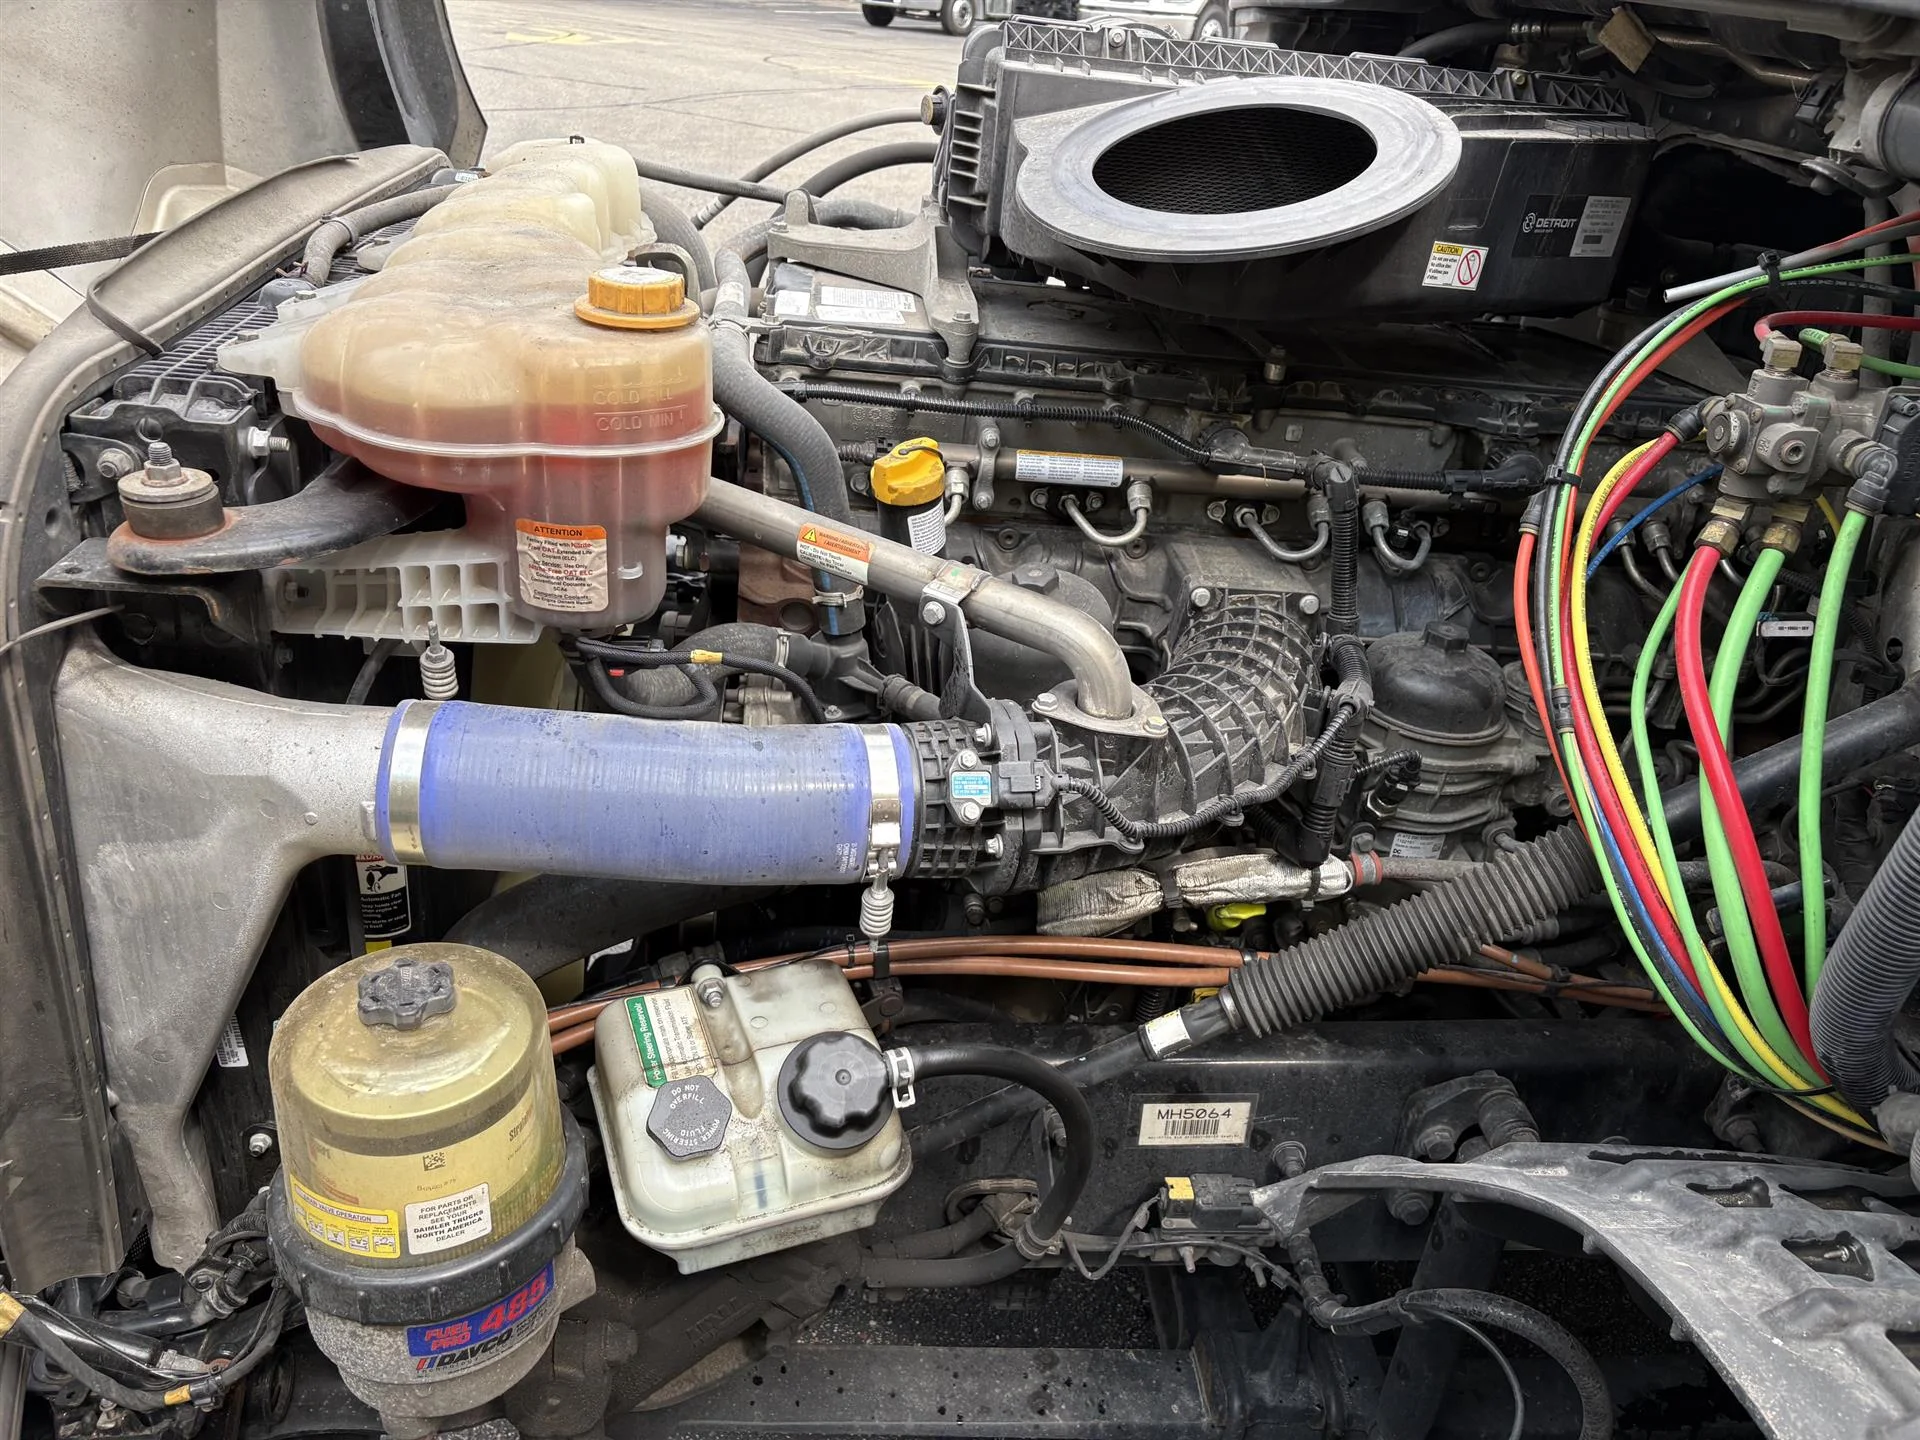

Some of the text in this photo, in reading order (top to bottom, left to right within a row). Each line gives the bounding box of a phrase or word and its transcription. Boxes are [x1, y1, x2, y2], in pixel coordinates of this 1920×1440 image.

[1535, 218, 1577, 228] DETROIT
[1436, 245, 1460, 254] CAUTION
[593, 390, 640, 405] COLD
[596, 412, 674, 431] COLD MIN
[534, 526, 583, 536] ATTENTION
[819, 532, 839, 542] WARNING
[828, 552, 843, 561] Touch
[832, 560, 845, 568] Tocar
[834, 566, 853, 576] Toucher
[361, 894, 390, 902] Automatic
[668, 1010, 681, 1041] Transmission
[680, 1016, 689, 1025] ATF
[634, 1002, 663, 1080] Power Steering Reservoir
[672, 1084, 700, 1096] DO NOT
[670, 1092, 705, 1110] OVERFILL
[1157, 1108, 1232, 1120] MH5064
[662, 1119, 720, 1146] POWER STEERING
[680, 1125, 706, 1137] FLUID
[418, 1200, 477, 1221] REPLACEMENTS
[420, 1194, 474, 1213] FOR PARTS OR
[319, 1203, 335, 1215] VALVE
[336, 1210, 372, 1222] OPERATION
[430, 1210, 468, 1224] SEE YOUR
[414, 1210, 484, 1234] DAIMLER TRUCKS
[416, 1230, 445, 1240] NORTH
[447, 1216, 483, 1233] AMERICA
[436, 1230, 465, 1242] DEALER
[424, 1321, 472, 1341] FUEL
[430, 1332, 471, 1351] PRO
[437, 1328, 513, 1367] DAVCO
